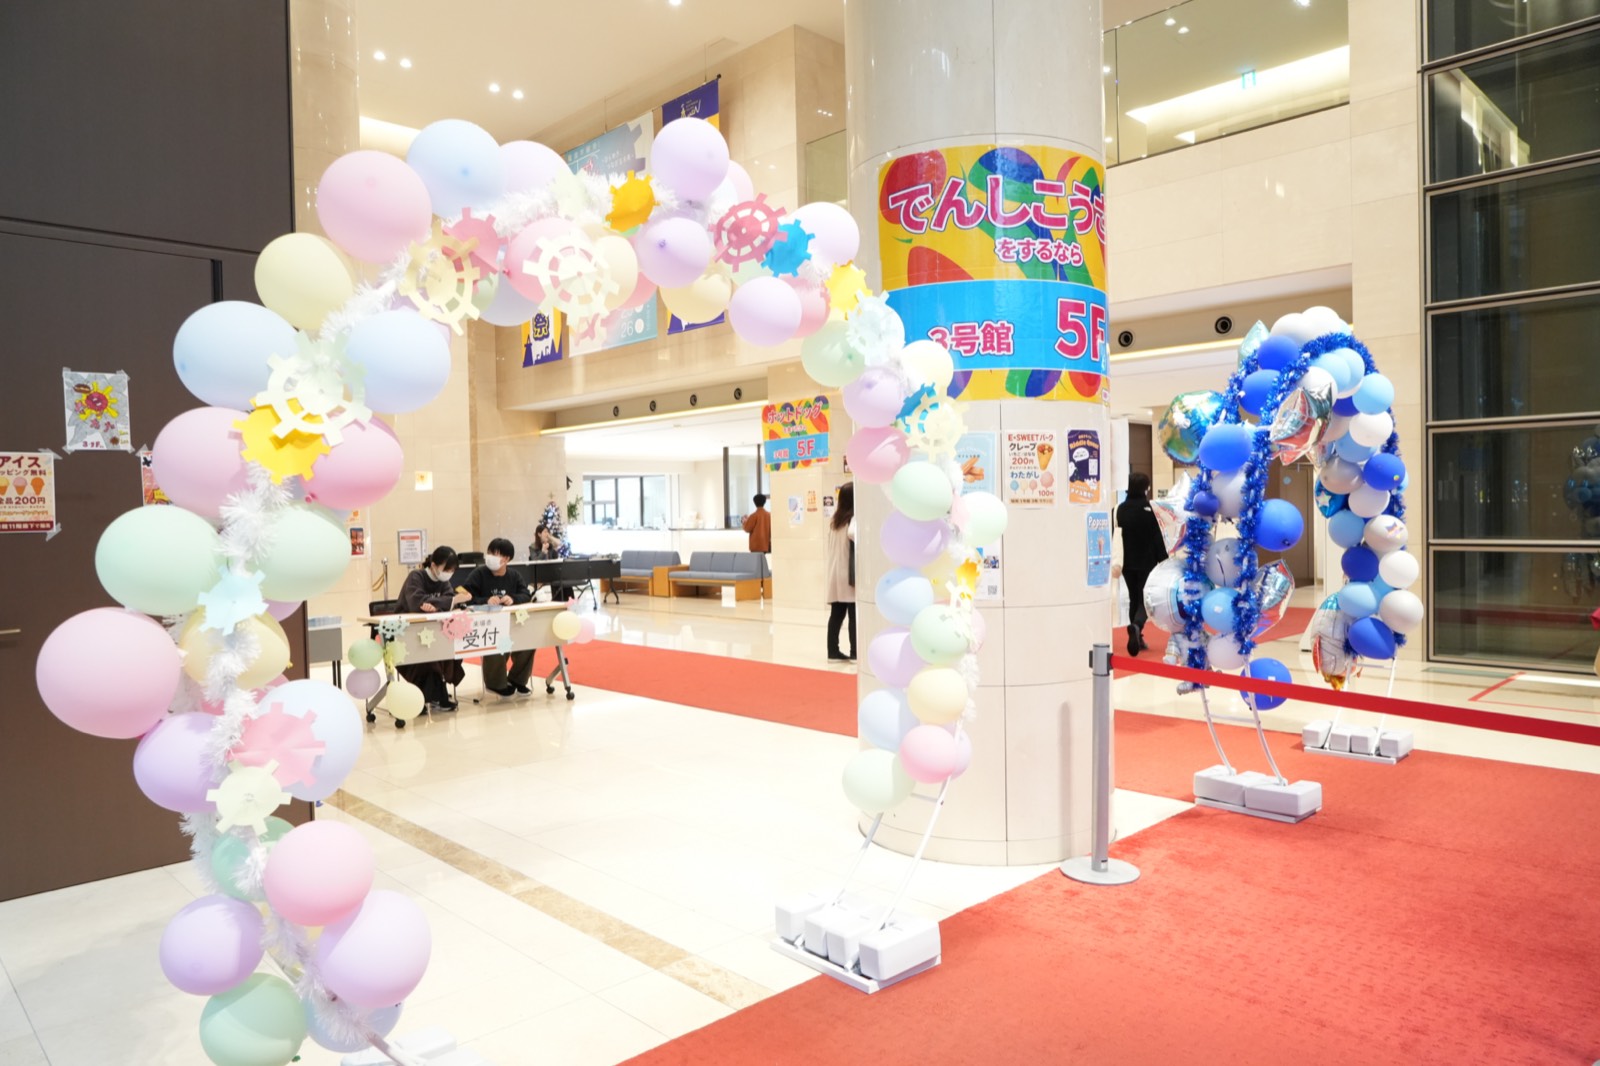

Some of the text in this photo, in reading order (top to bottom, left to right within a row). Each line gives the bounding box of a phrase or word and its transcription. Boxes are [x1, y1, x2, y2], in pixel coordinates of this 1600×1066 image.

[996, 237, 1083, 267] をするなら
[928, 321, 1014, 357] 3号館
[1055, 298, 1106, 362] 5F
[768, 402, 822, 423] ホットドッグ
[798, 440, 815, 456] 5F
[1009, 443, 1037, 451] クレープ
[1012, 457, 1034, 465] 200円
[1011, 471, 1040, 479] わたがし
[463, 627, 499, 649] 受付
